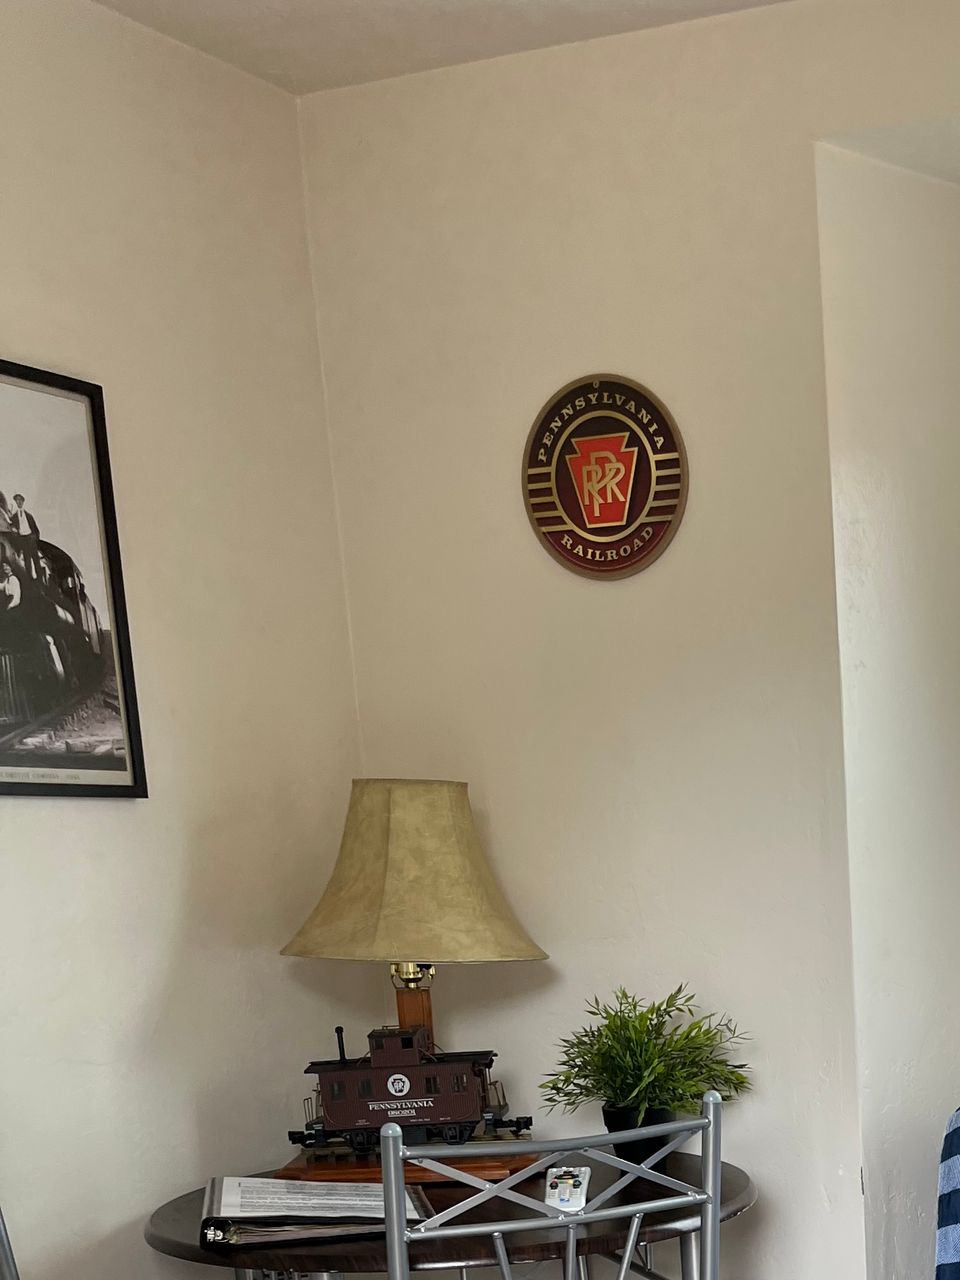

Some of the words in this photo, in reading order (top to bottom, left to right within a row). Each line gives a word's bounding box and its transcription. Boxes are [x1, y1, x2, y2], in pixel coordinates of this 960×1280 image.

[538, 392, 665, 463] PENNSYLVANIA
[561, 526, 654, 561] RAILROAD
[369, 1101, 433, 1110] PENNSYLVANIA
